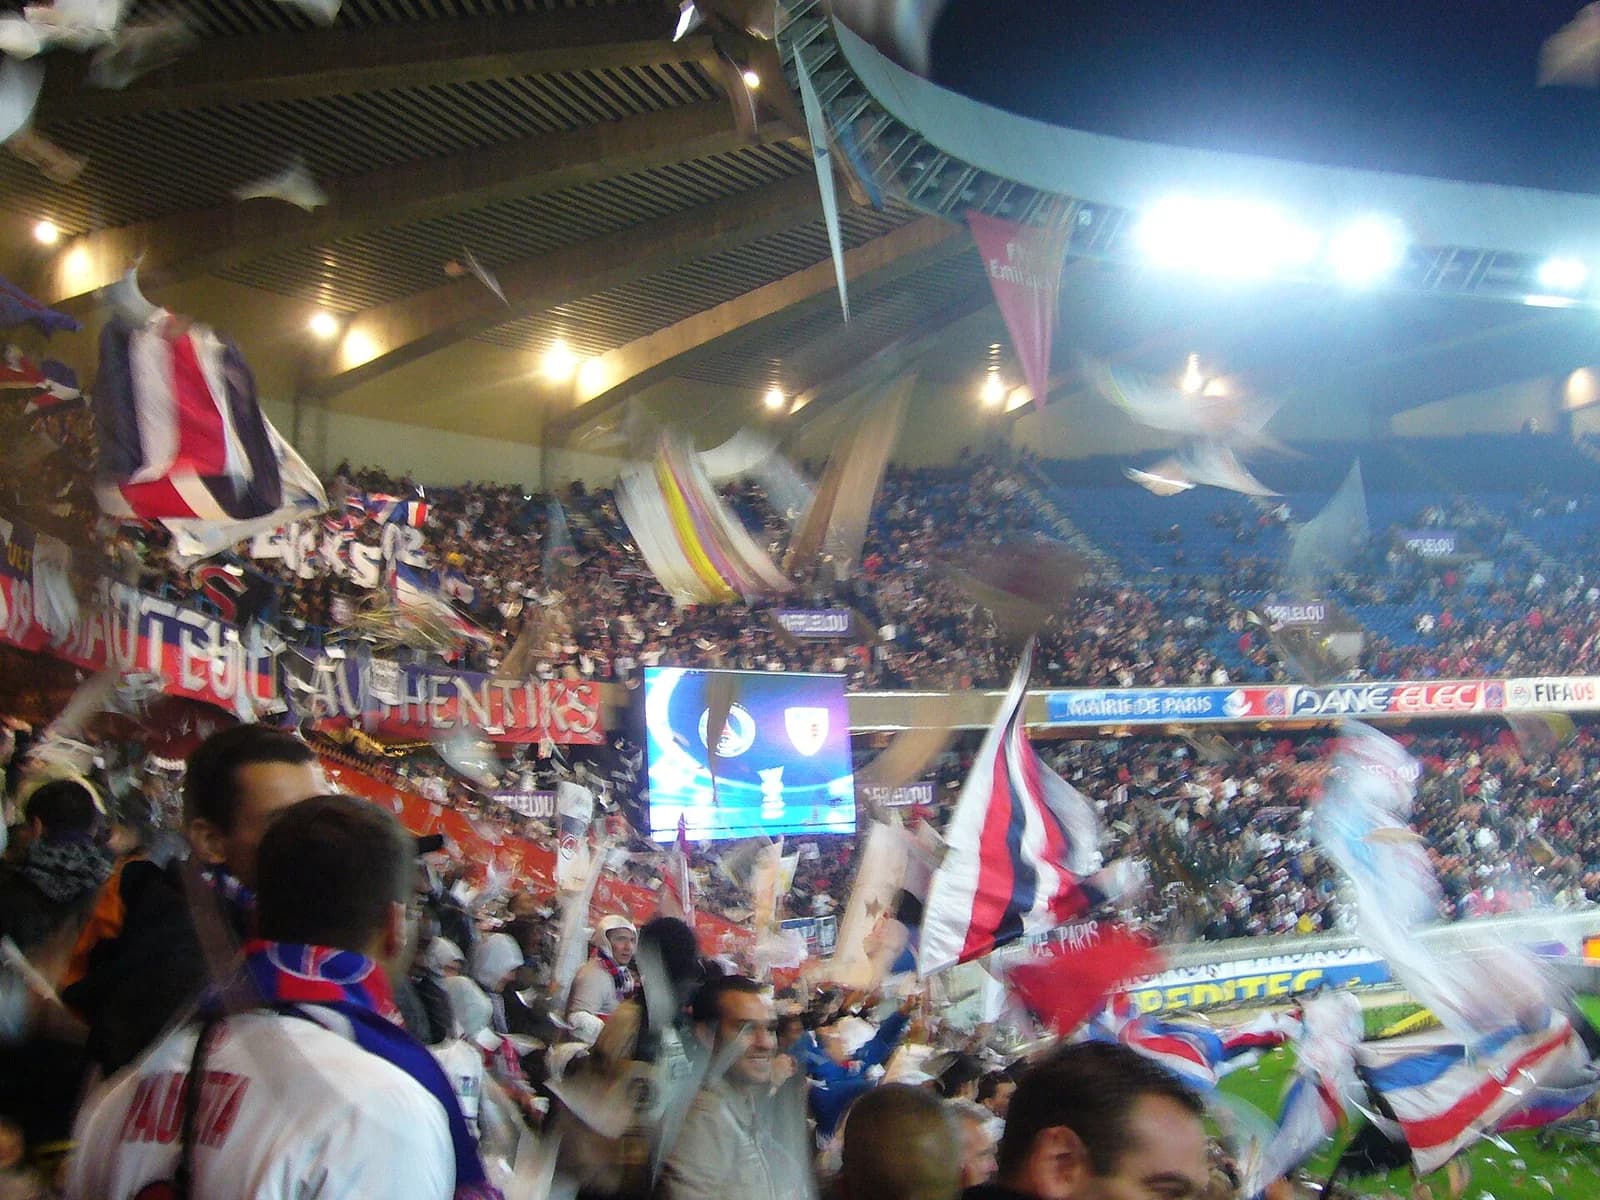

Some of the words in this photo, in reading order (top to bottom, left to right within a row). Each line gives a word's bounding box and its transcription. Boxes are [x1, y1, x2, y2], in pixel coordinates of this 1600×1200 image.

[1067, 697, 1132, 716] MAIRIE
[1134, 697, 1161, 715] DE
[1162, 695, 1212, 714] PARIS
[1057, 920, 1100, 955] PARIS
